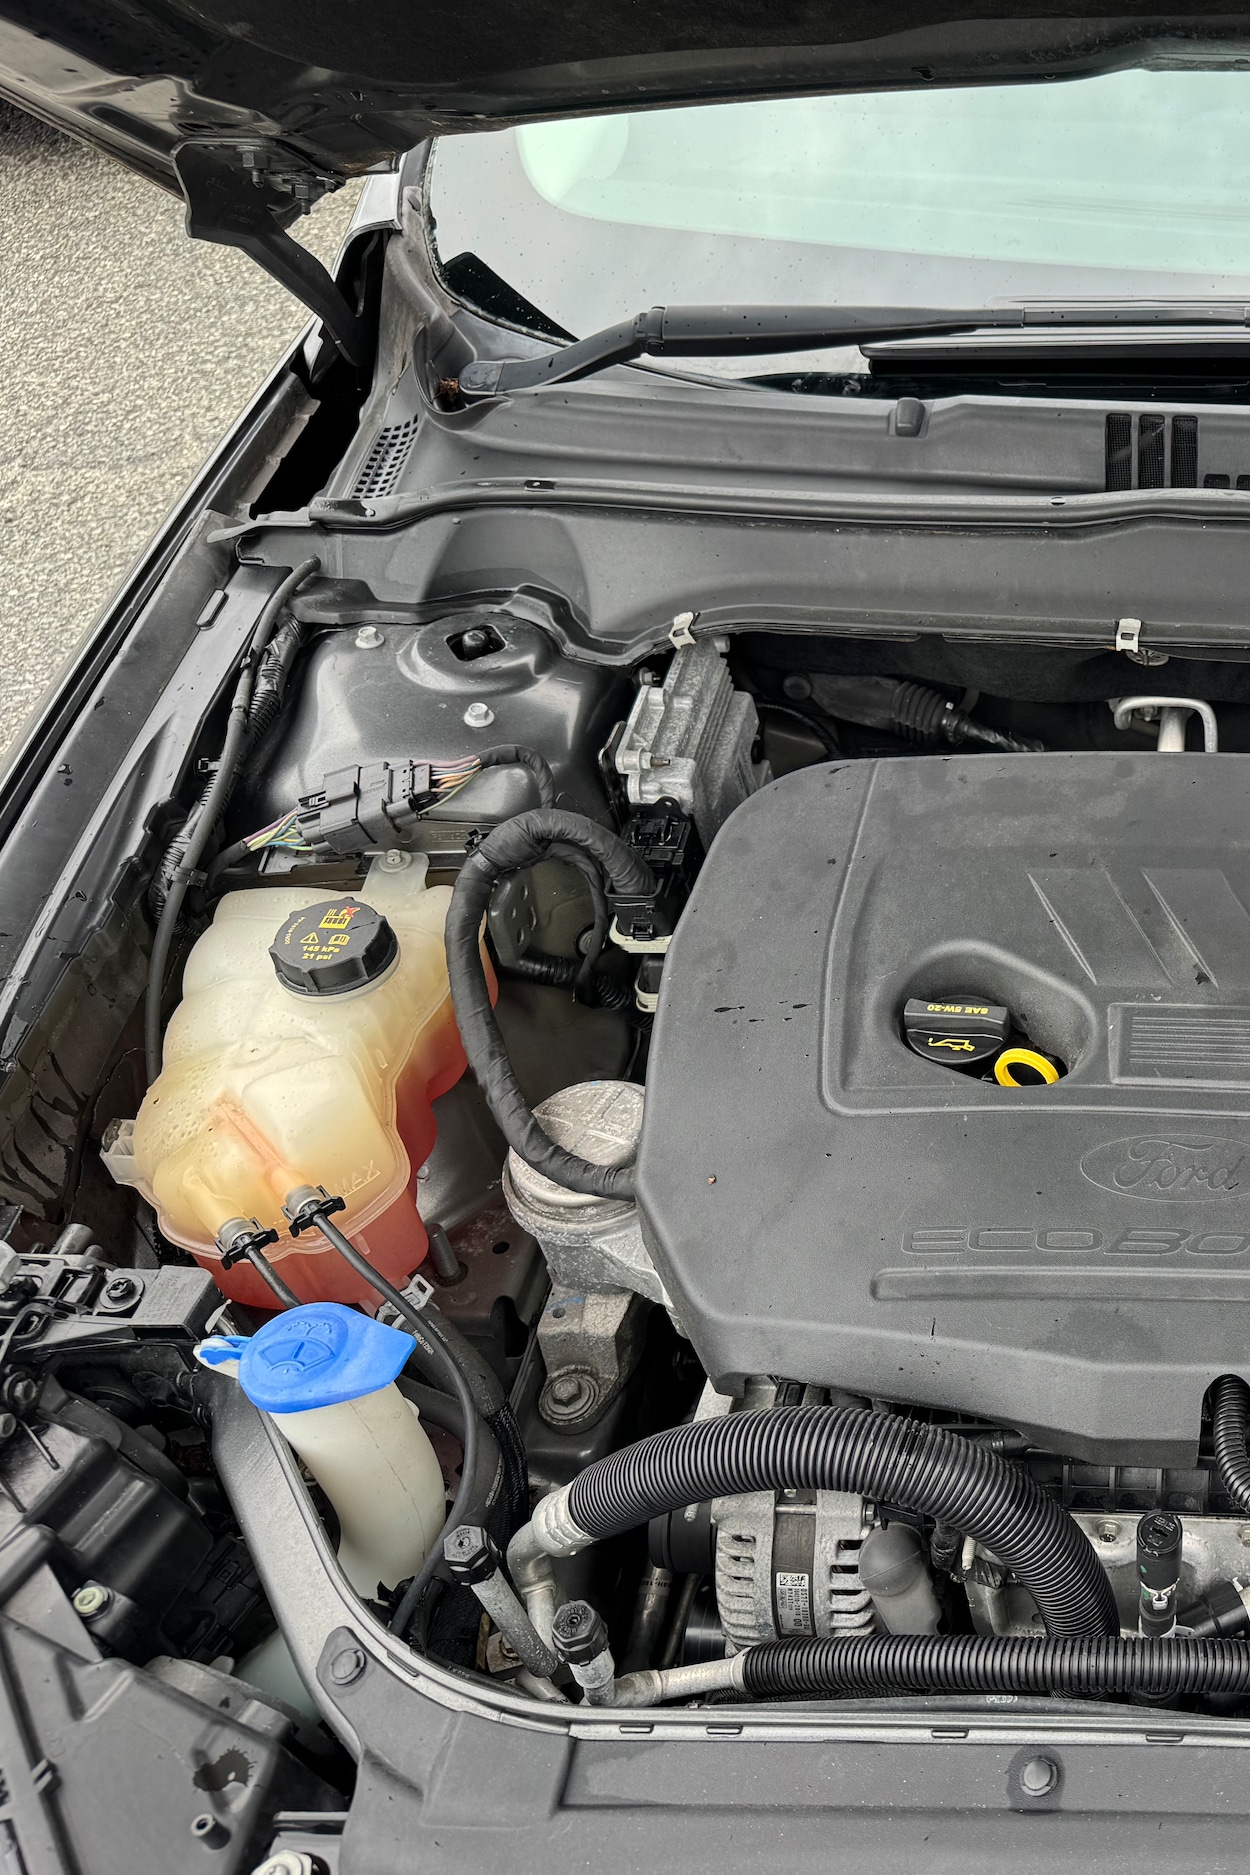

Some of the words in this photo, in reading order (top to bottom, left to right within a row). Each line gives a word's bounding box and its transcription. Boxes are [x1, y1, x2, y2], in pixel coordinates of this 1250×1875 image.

[926, 1004, 963, 1013] 5W-20
[964, 1006, 989, 1015] SAE
[1112, 1138, 1243, 1192] Ford
